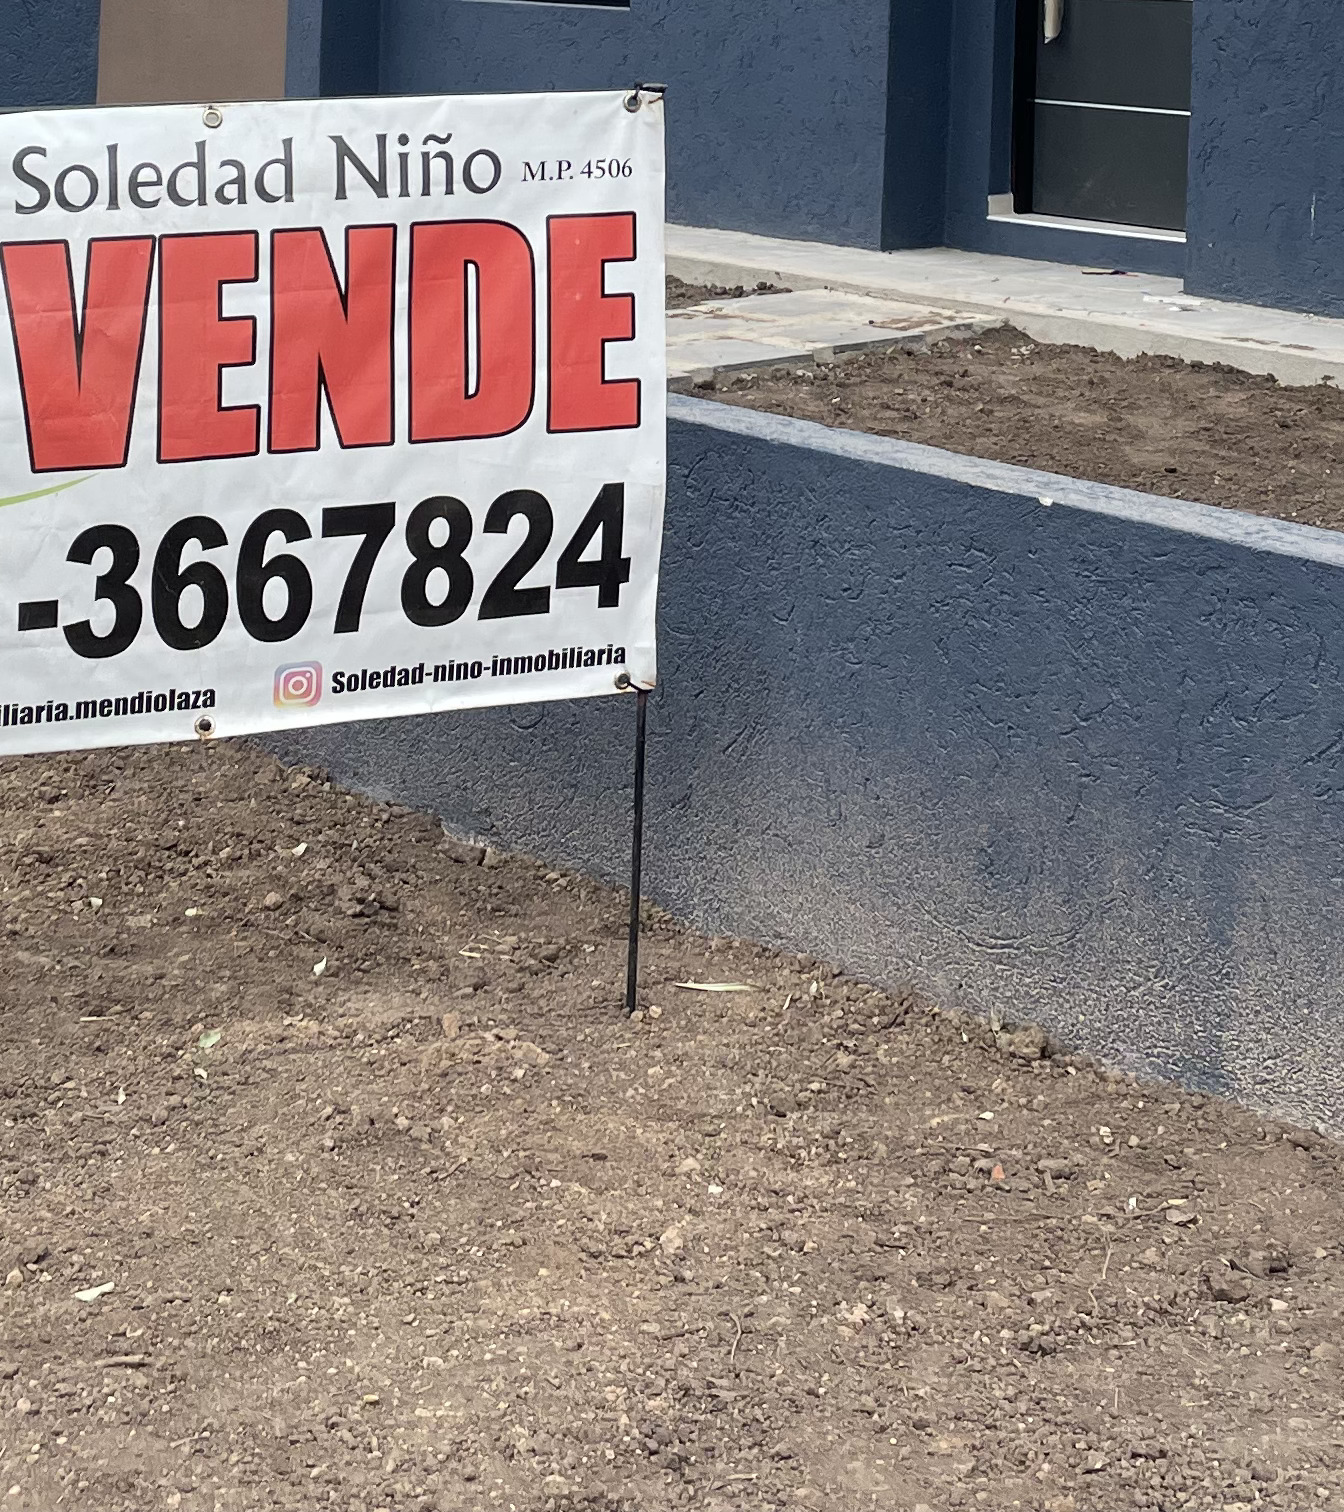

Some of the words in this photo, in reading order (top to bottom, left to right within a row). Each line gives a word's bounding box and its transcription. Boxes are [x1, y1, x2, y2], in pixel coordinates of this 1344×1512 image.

[13, 136, 295, 214] Soledad
[328, 132, 502, 201] Niño
[520, 159, 574, 182] M.P.
[579, 157, 634, 179] 4506
[331, 646, 626, 694] Soledad-nino-inmobiliaria
